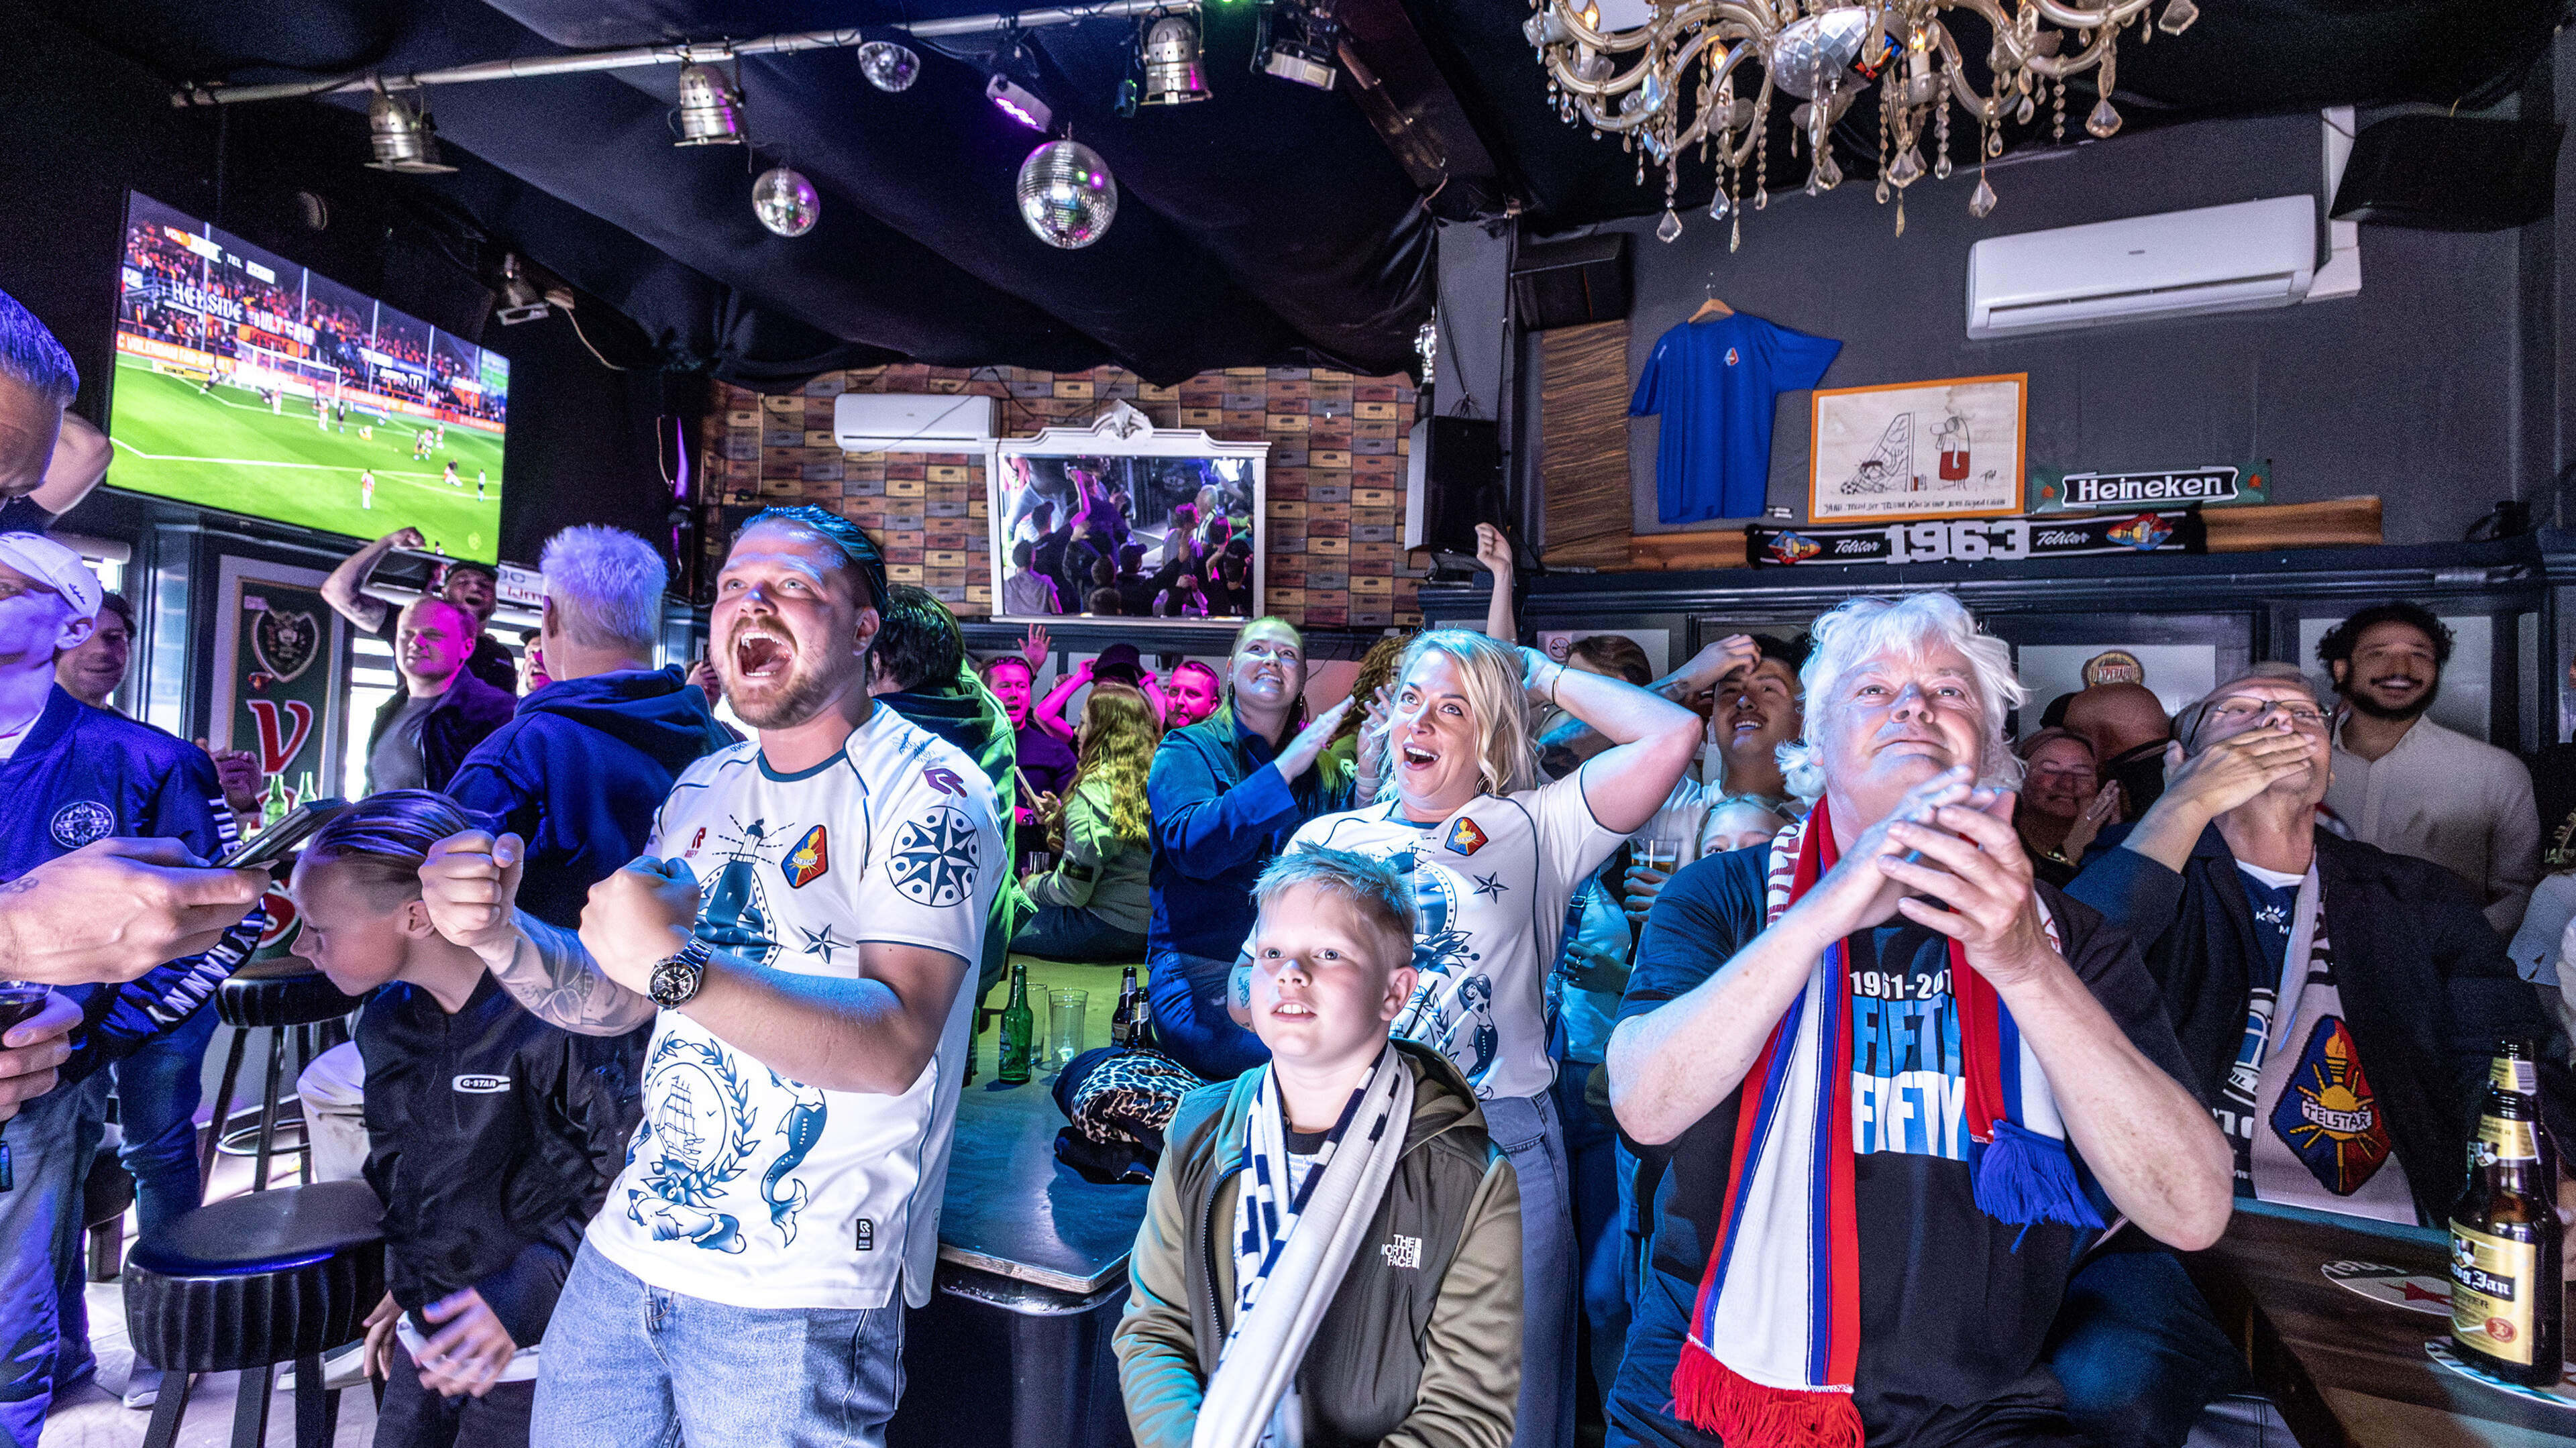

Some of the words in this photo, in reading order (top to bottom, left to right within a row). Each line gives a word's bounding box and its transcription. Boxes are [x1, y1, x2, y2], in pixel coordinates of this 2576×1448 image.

[2078, 475, 2222, 502] Heineken
[1834, 539, 1880, 554] Telstar
[1885, 519, 2031, 565] 1963
[2036, 530, 2090, 547] Telstar
[1849, 968, 1952, 999] 1961-201
[1851, 992, 1962, 1079] FIFTY
[462, 1079, 497, 1088] G-STAR
[1851, 1070, 1966, 1161] FIFTY
[2304, 1105, 2368, 1129] TELSTAR
[1393, 1234, 1415, 1248] THE
[1387, 1256, 1412, 1268] FACE
[2472, 1270, 2512, 1295] Jan
